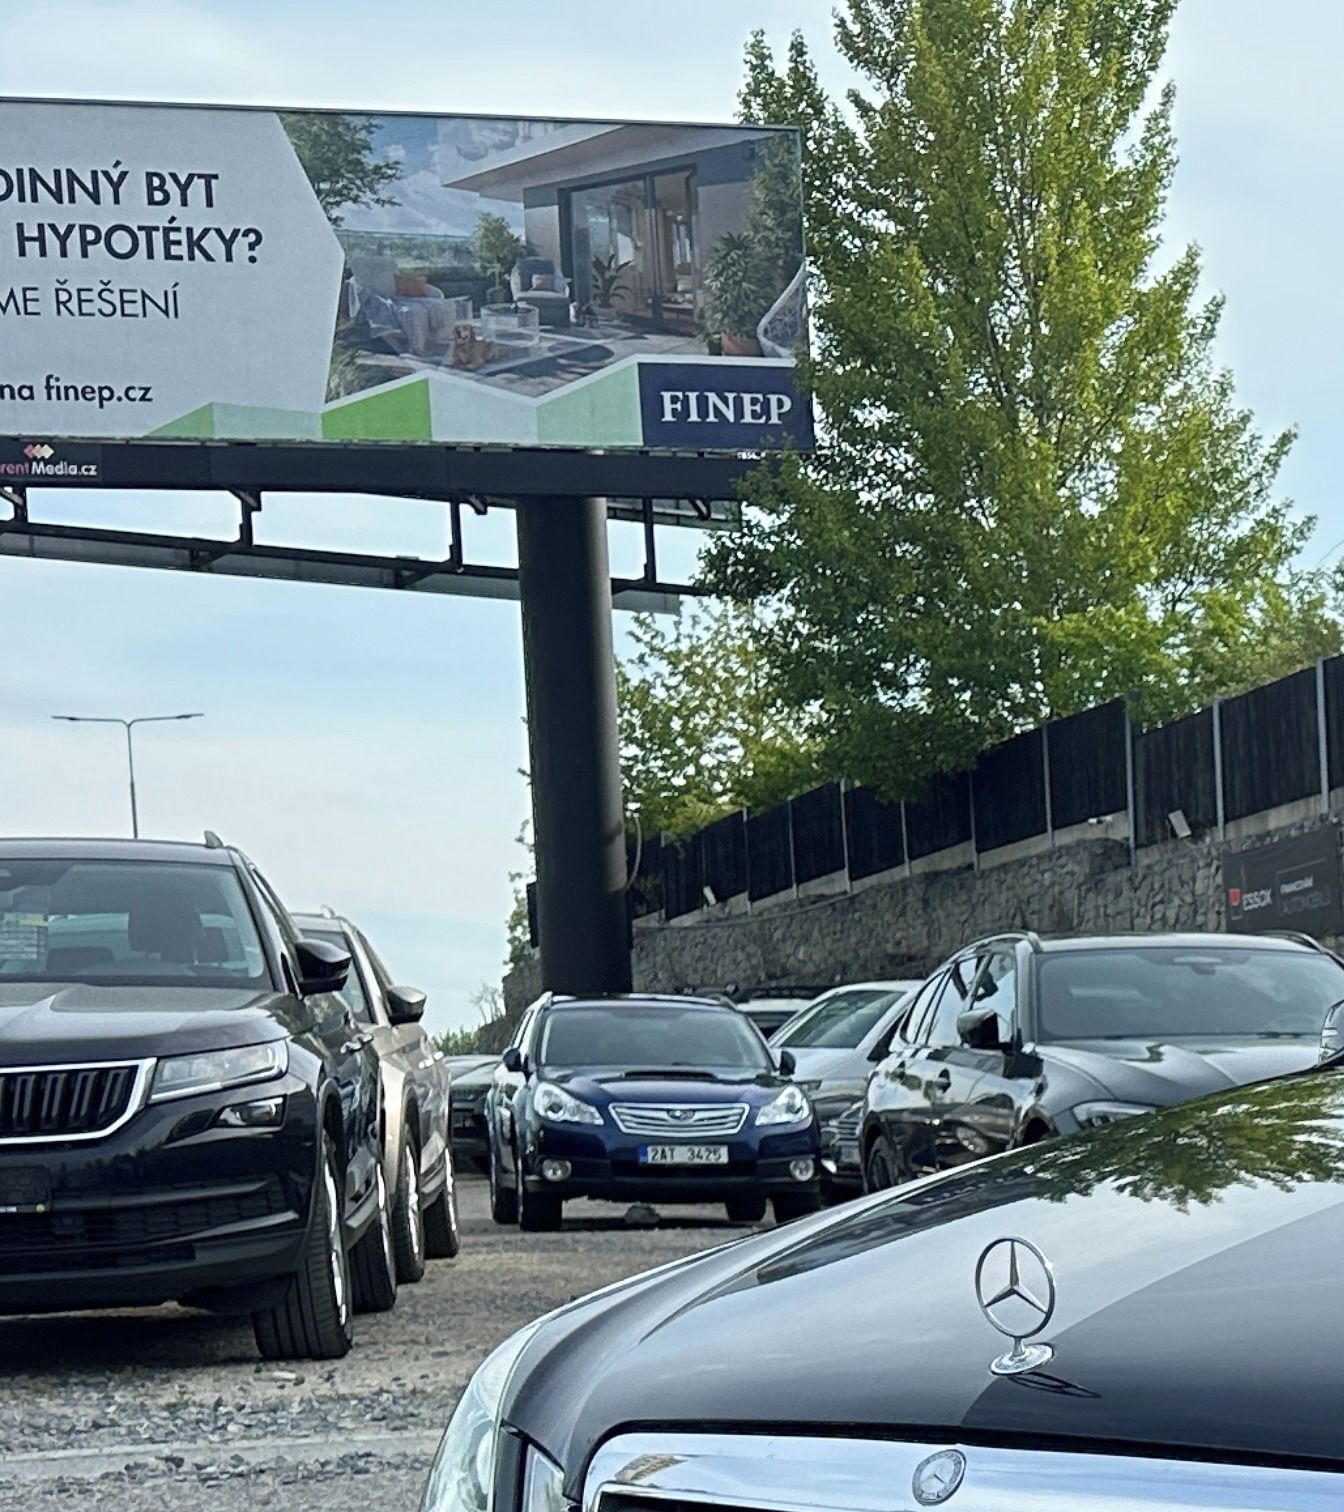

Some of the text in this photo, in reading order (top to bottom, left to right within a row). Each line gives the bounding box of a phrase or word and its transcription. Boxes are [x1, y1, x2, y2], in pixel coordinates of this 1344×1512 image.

[145, 171, 219, 208] BYT
[16, 216, 263, 264] HYPOTÉKY?
[54, 279, 180, 319] ŘEŠENÍ
[0, 374, 153, 409] na finep.cz
[660, 391, 793, 425] FINEP
